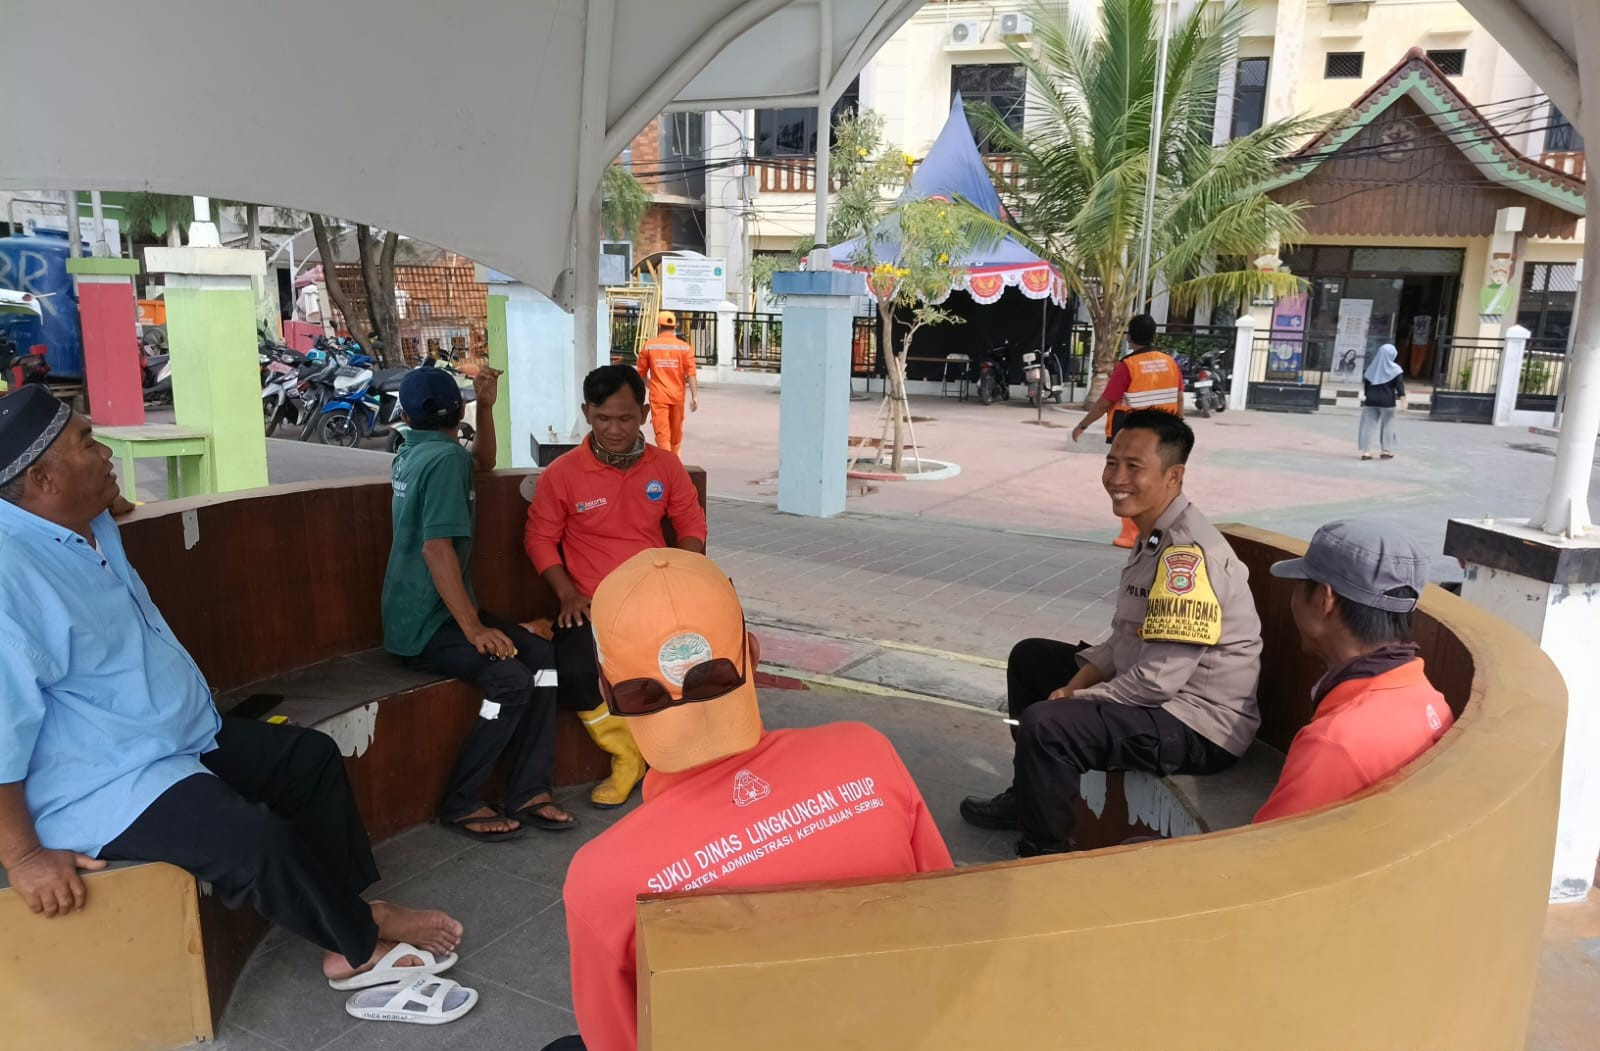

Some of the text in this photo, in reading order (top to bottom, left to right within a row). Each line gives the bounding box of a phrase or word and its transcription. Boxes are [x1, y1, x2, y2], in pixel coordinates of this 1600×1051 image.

[1175, 619, 1209, 628] KELAPA
[1167, 629, 1190, 637] SERIBU
[1183, 625, 1208, 633] KELAPA
[648, 777, 875, 893] SUKU DINAS LINGKUNGAN HIDUP
[682, 797, 884, 891] PATEN ADMINISTRASI KEPULAUAN SERIBU
